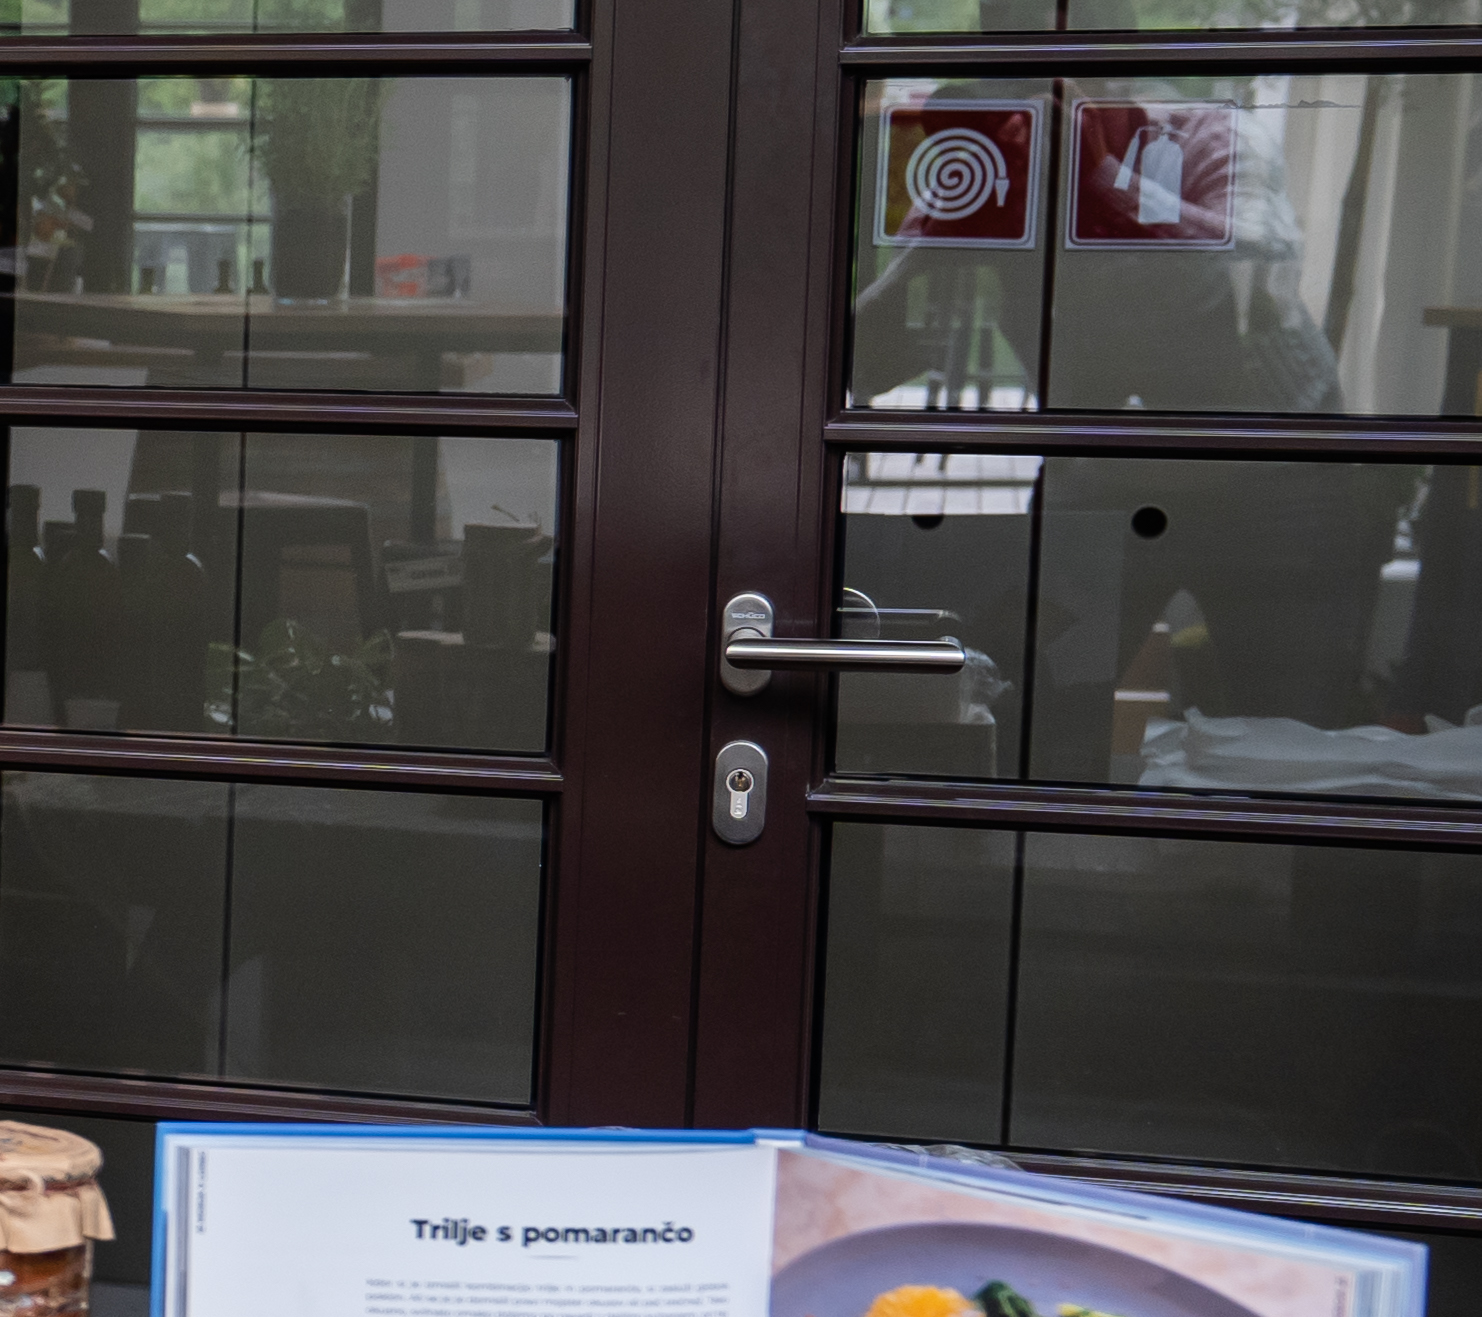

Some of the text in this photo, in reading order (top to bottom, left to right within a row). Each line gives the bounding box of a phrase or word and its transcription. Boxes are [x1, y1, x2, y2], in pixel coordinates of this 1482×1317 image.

[411, 1217, 695, 1249] Trilje s pomarančo
